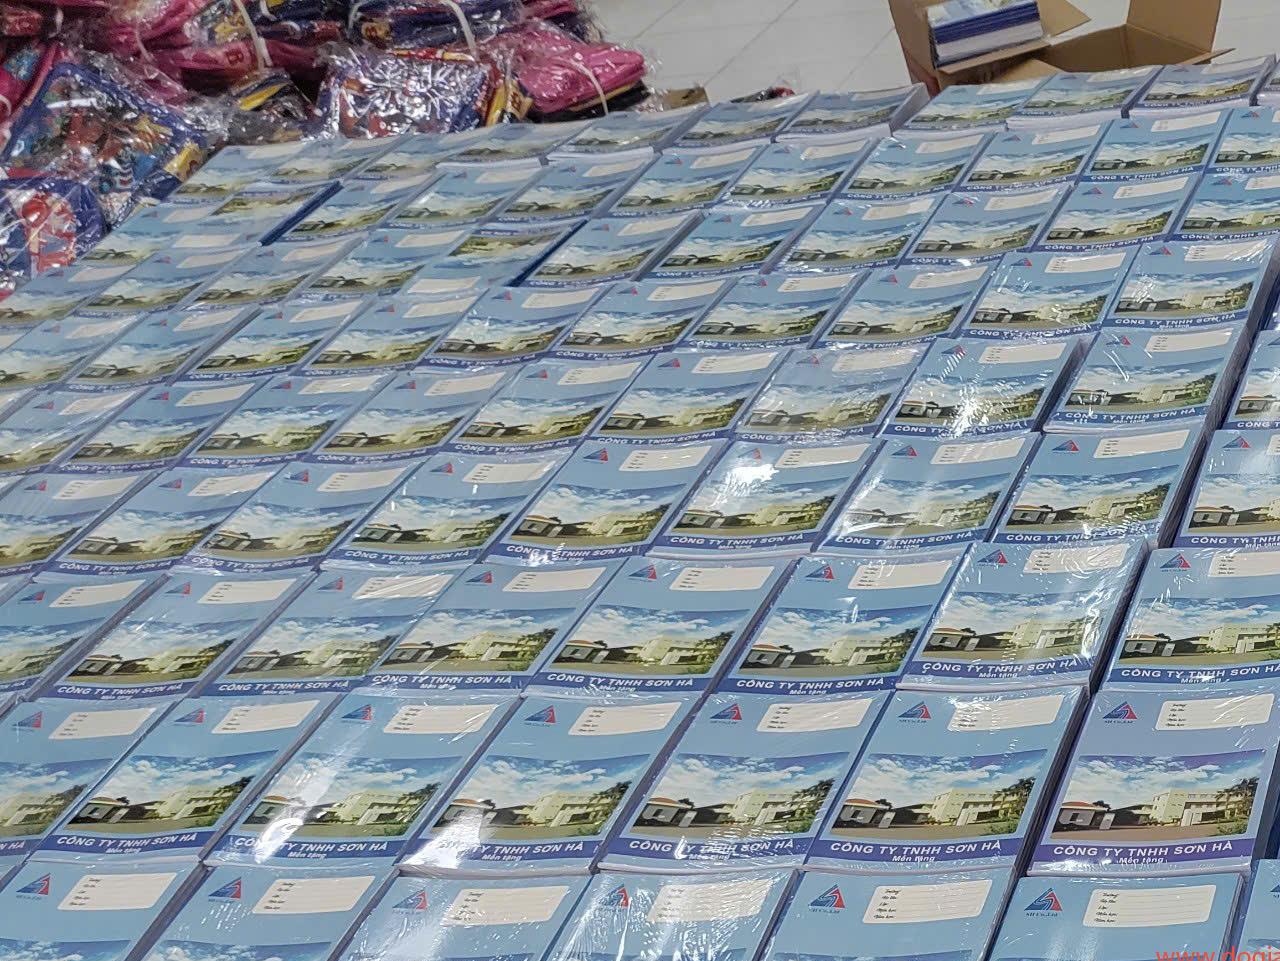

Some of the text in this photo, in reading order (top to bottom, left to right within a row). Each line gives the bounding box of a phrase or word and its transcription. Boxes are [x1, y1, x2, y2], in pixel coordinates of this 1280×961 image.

[830, 838, 1002, 856] CÔNG TY TNHH SƠN HÀ
[1053, 839, 1234, 858] CÔNG TY TNHH SƠN HÀ
